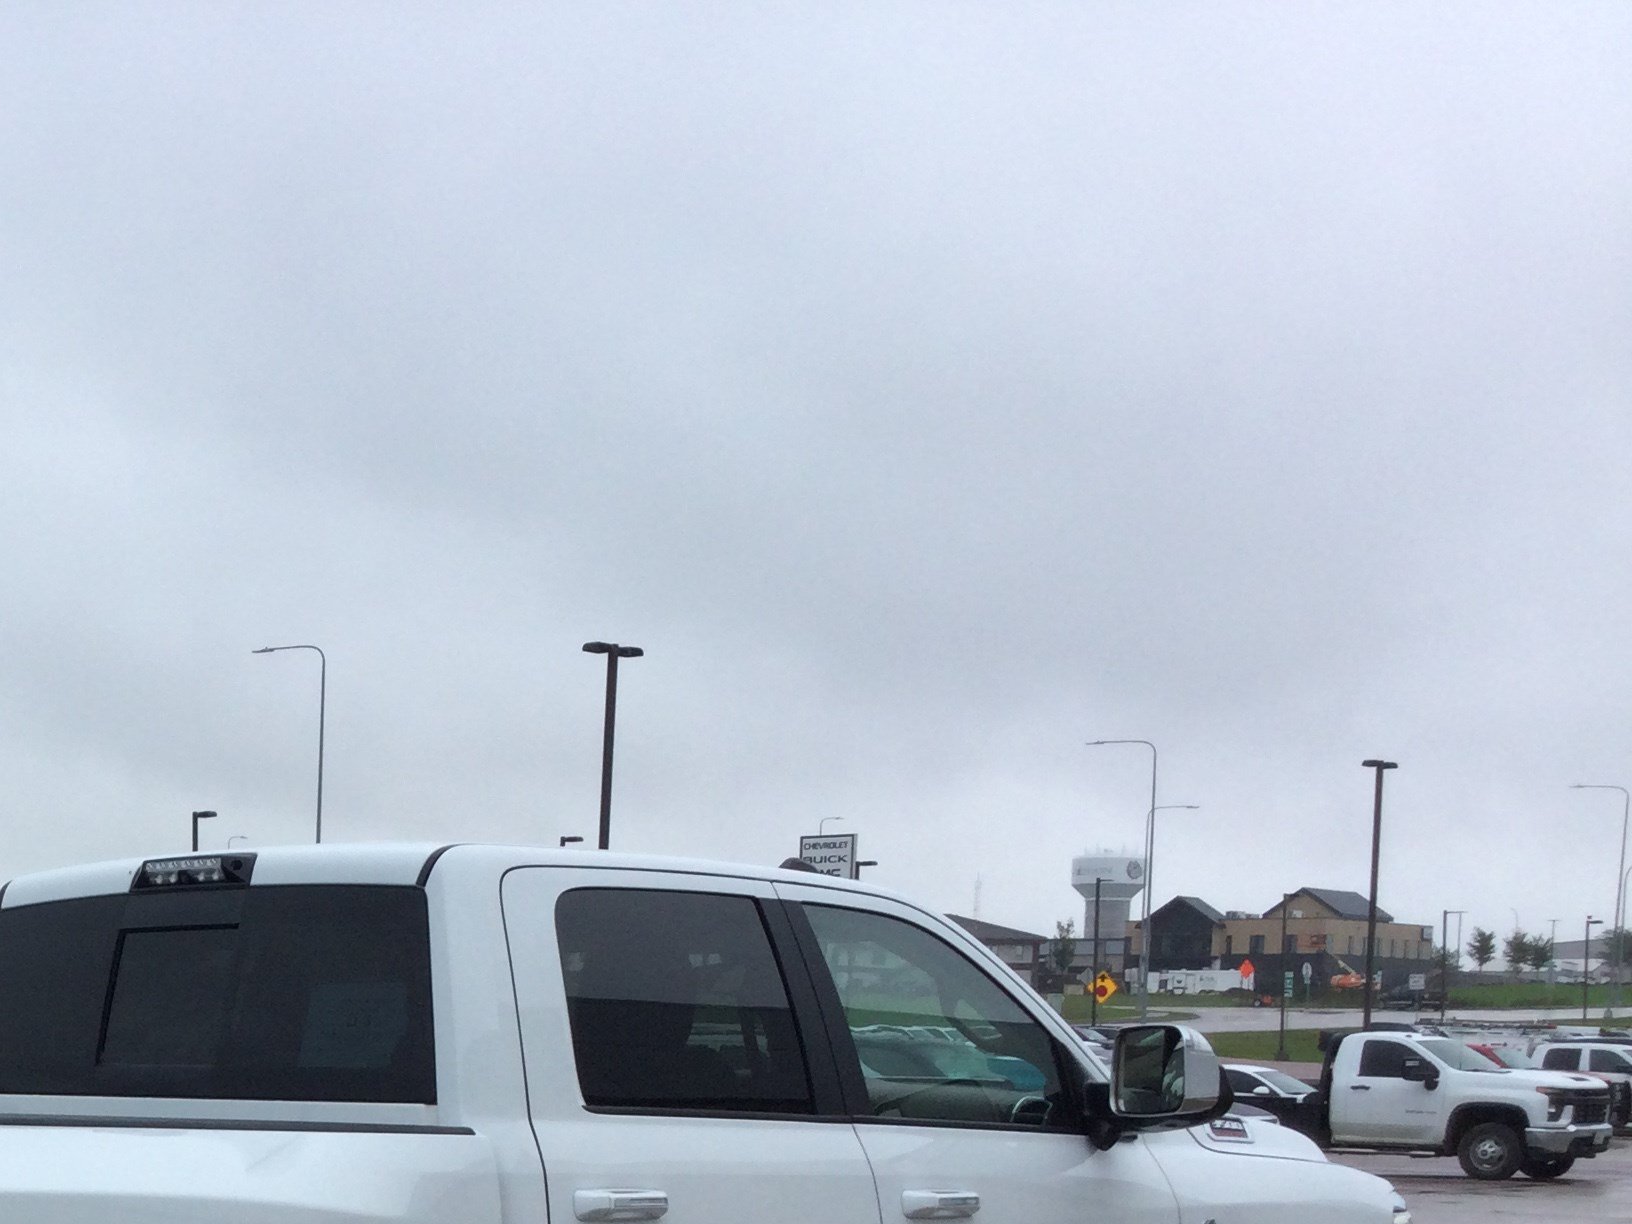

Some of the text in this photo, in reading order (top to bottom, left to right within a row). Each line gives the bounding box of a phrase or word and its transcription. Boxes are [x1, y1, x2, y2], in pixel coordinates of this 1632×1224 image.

[803, 841, 848, 850] CHEVROLET
[803, 855, 848, 863] BUICK
[820, 869, 841, 877] MC
